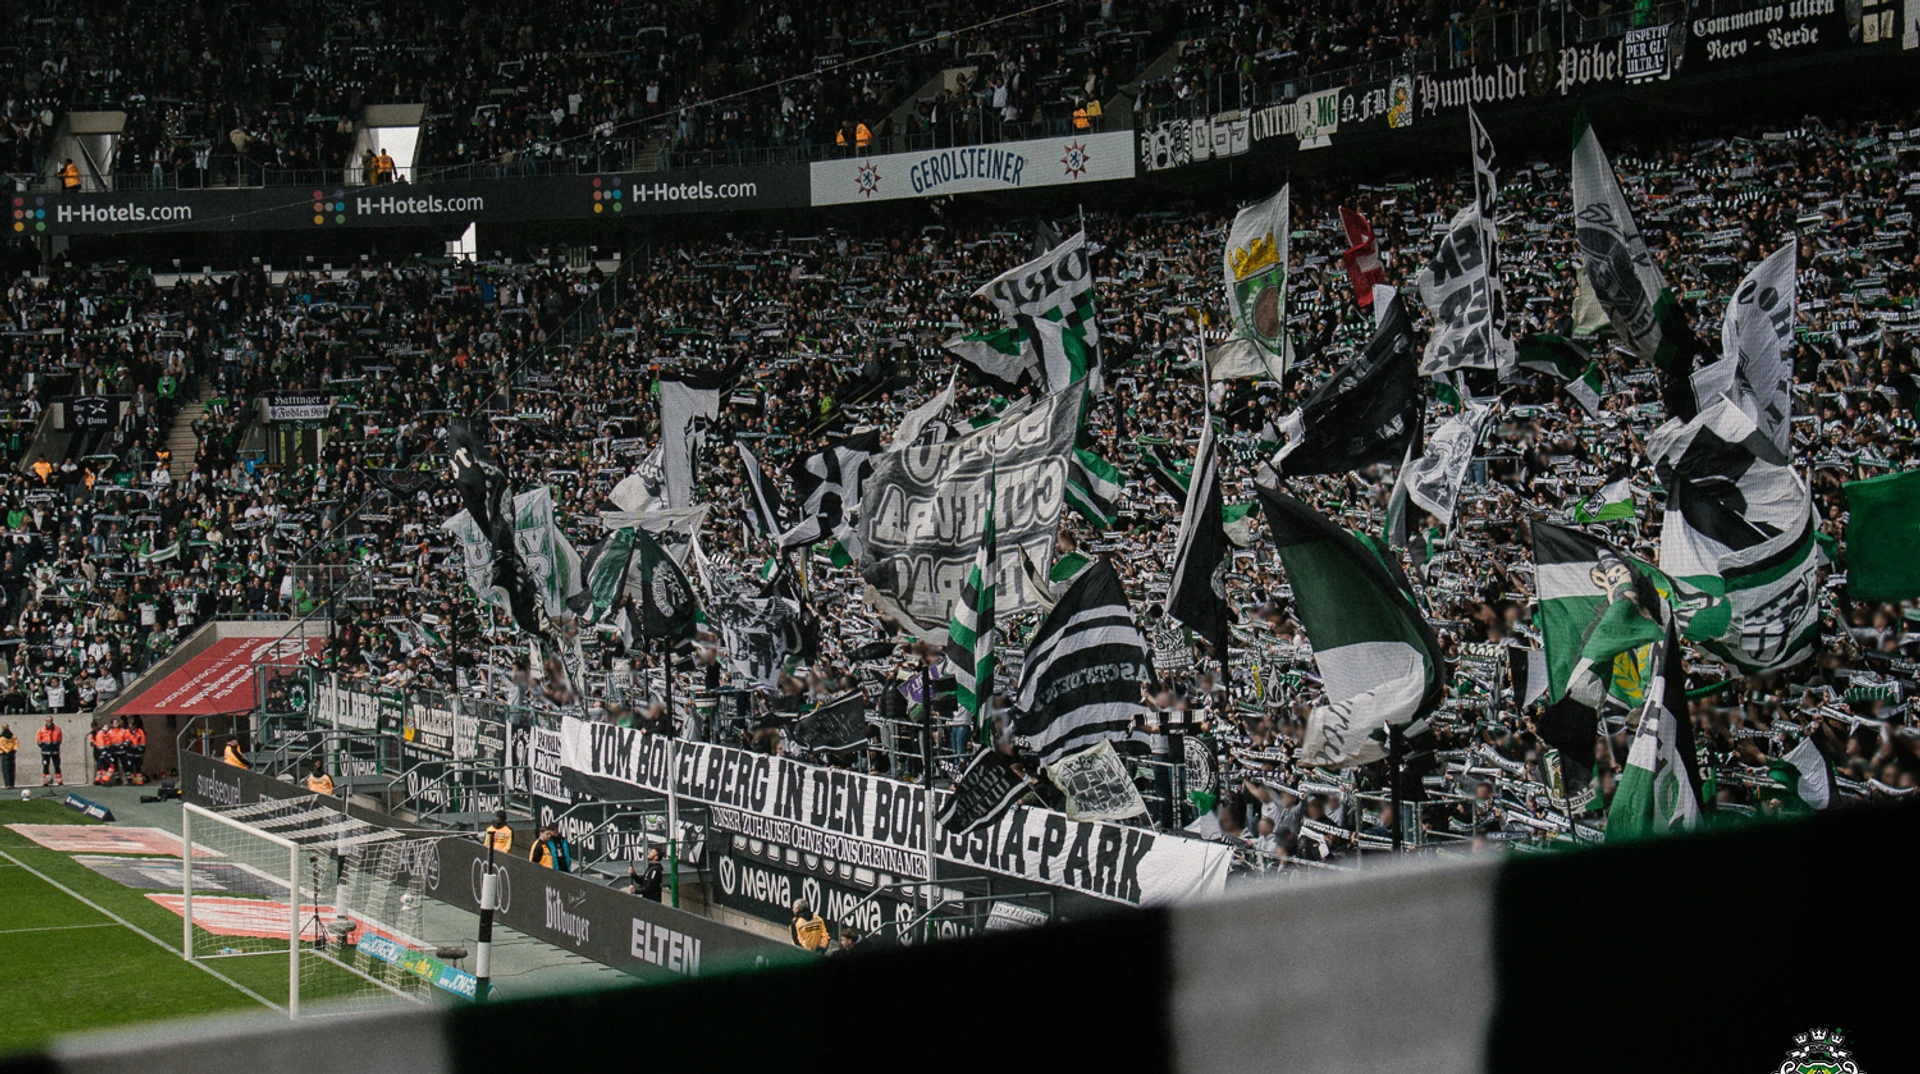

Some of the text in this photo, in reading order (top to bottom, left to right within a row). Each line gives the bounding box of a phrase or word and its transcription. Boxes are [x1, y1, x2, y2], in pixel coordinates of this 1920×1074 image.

[1625, 23, 1669, 45] RISPETTO
[1693, 5, 1784, 38] Commando
[1626, 43, 1647, 58] PER
[1417, 38, 1625, 118] Humboldt Pöbel
[1251, 103, 1297, 142] UNITED
[1316, 94, 1337, 128] MG
[632, 178, 757, 202] H-Hotels.com
[910, 147, 1024, 195] GEROLSTEINER
[57, 202, 192, 223] H-Hotels.com
[356, 195, 485, 216] H-Hotels.com
[274, 395, 321, 406] Hattinger
[317, 684, 380, 730] BOELBERG
[590, 723, 635, 780] VOM
[773, 756, 805, 822] IN
[810, 766, 868, 837] DEN
[557, 813, 596, 851] mewa
[710, 805, 929, 880] UNSER ZUHAUSE OHNE SPONSORENNAMEN
[741, 865, 791, 909] mewa
[545, 885, 590, 947] Bitburger
[826, 888, 882, 936] mewa
[631, 917, 701, 977] ELTEN
